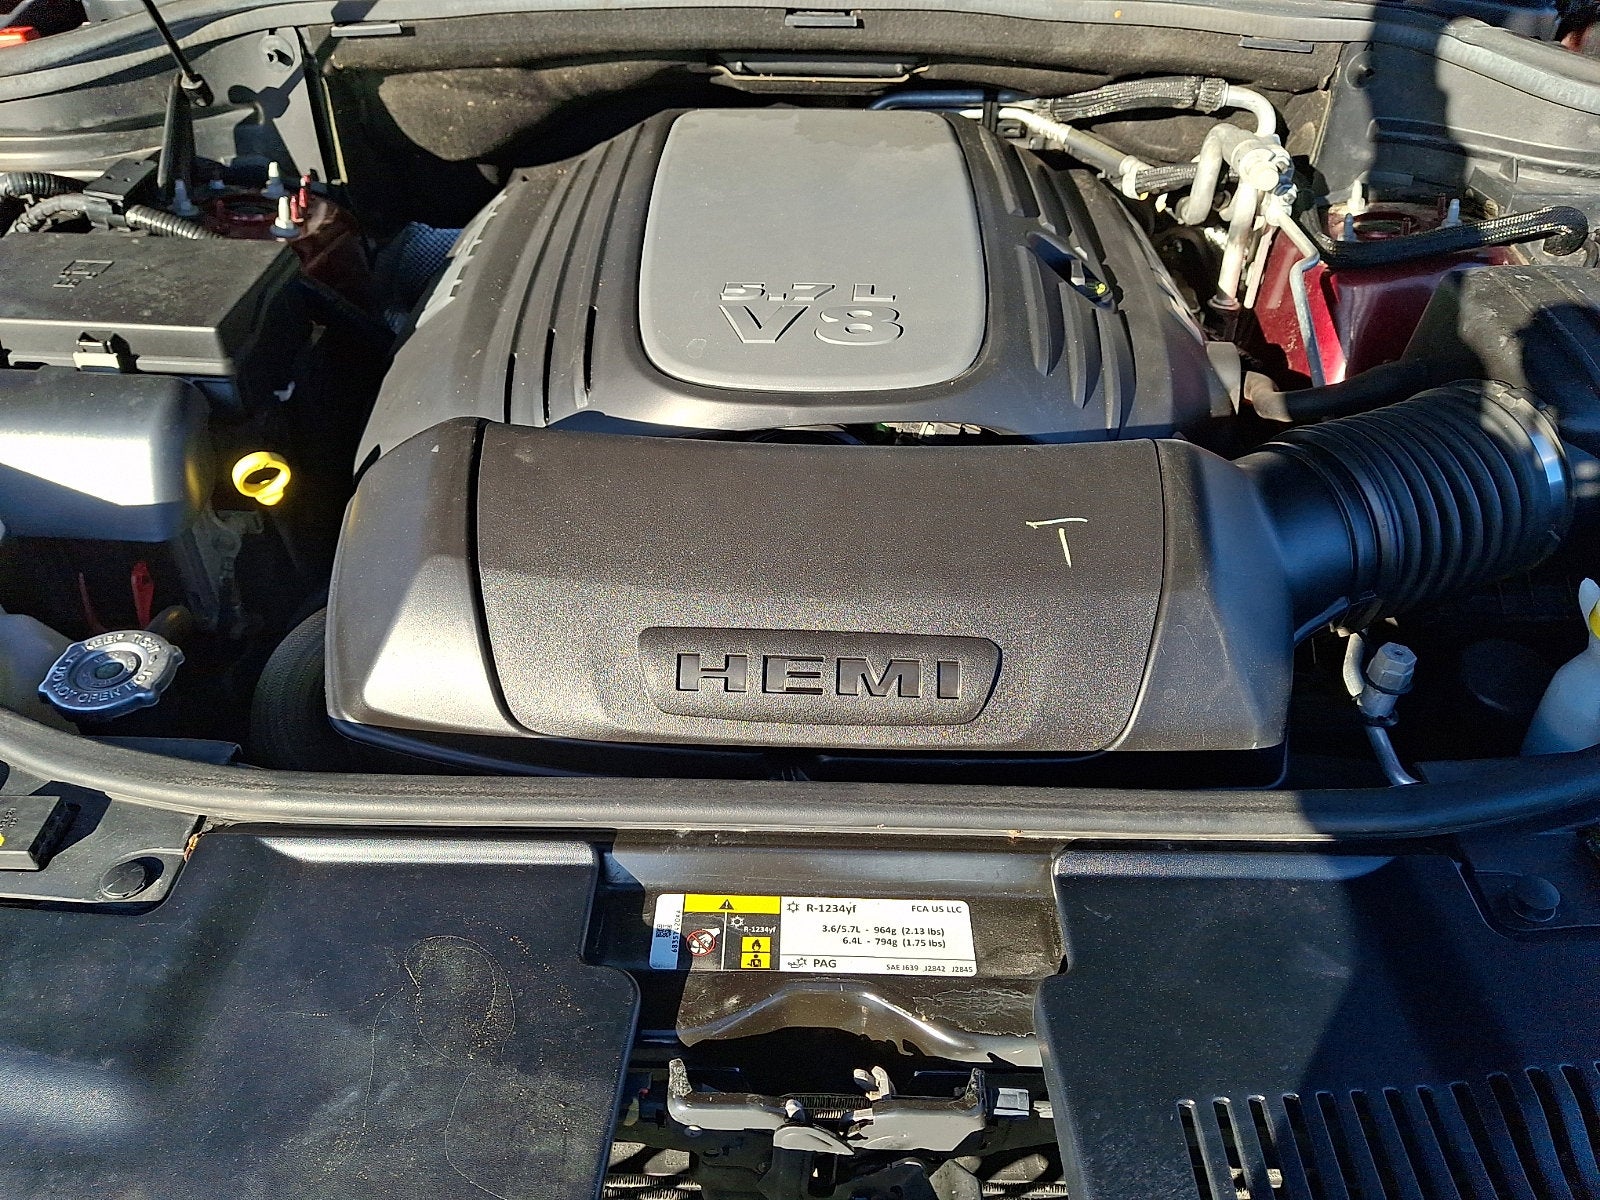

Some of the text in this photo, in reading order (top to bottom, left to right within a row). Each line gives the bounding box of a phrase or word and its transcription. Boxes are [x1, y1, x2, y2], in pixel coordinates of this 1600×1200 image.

[719, 304, 905, 346] V8
[676, 652, 961, 699] HEMI
[77, 689, 122, 704] OPEN
[806, 904, 856, 915] R-1234yf
[911, 905, 929, 913] FCA
[946, 906, 962, 914] LLC
[743, 925, 777, 935] R-1234yf
[822, 925, 861, 934] 3.6/5.7L
[873, 926, 897, 936] 964g
[901, 926, 925, 936] (2.13
[927, 927, 945, 937] lbs)
[842, 936, 862, 945] 6.4L
[875, 937, 898, 948] 794g
[902, 938, 926, 948] (1.75
[928, 939, 946, 949] lbs)
[813, 959, 837, 969] PAG
